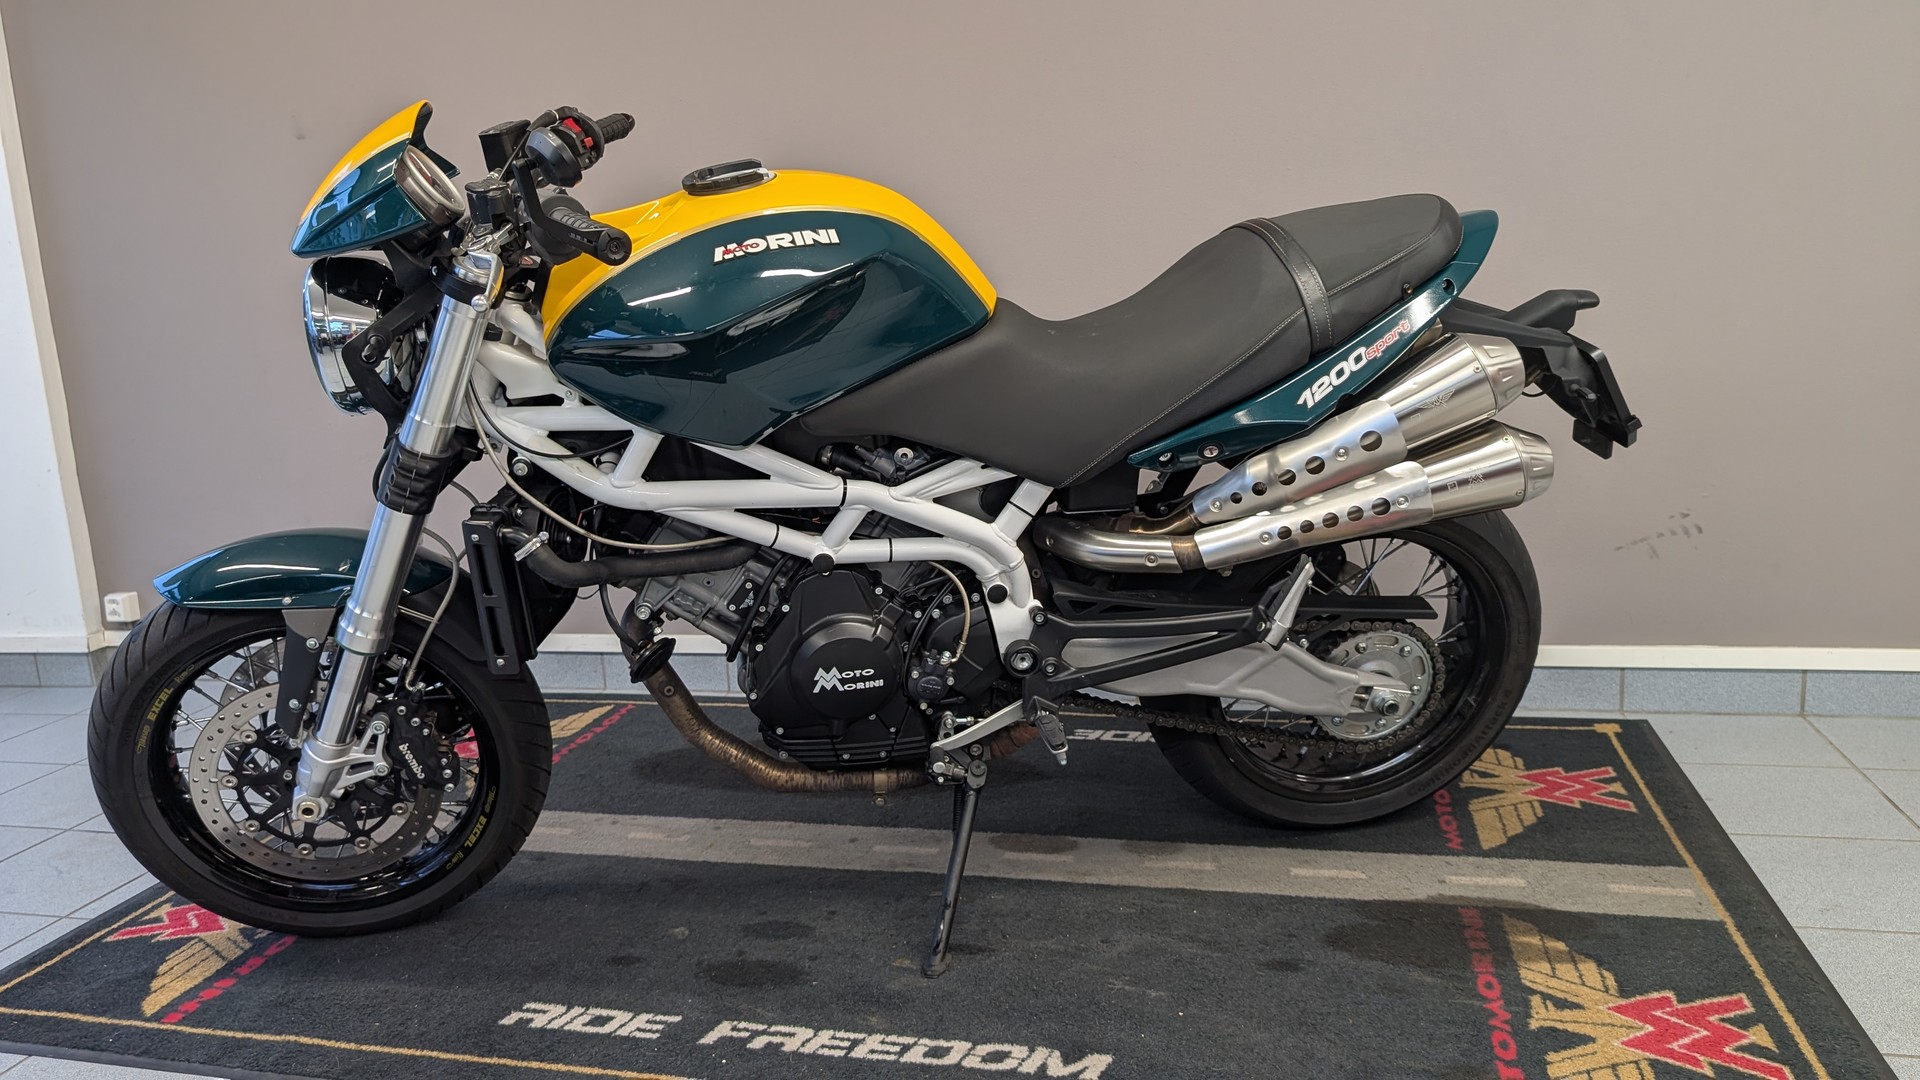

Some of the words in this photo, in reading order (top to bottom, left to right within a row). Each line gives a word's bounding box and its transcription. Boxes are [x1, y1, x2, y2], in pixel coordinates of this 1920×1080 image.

[714, 229, 840, 263] MORINI
[1296, 346, 1368, 409] 1200
[1364, 319, 1411, 361] sport
[146, 687, 174, 722] EXCEL
[398, 742, 425, 779] brembo
[464, 815, 487, 848] EXCEL
[500, 1001, 684, 1040] RIDE
[699, 1020, 1114, 1080] FREEDOM
